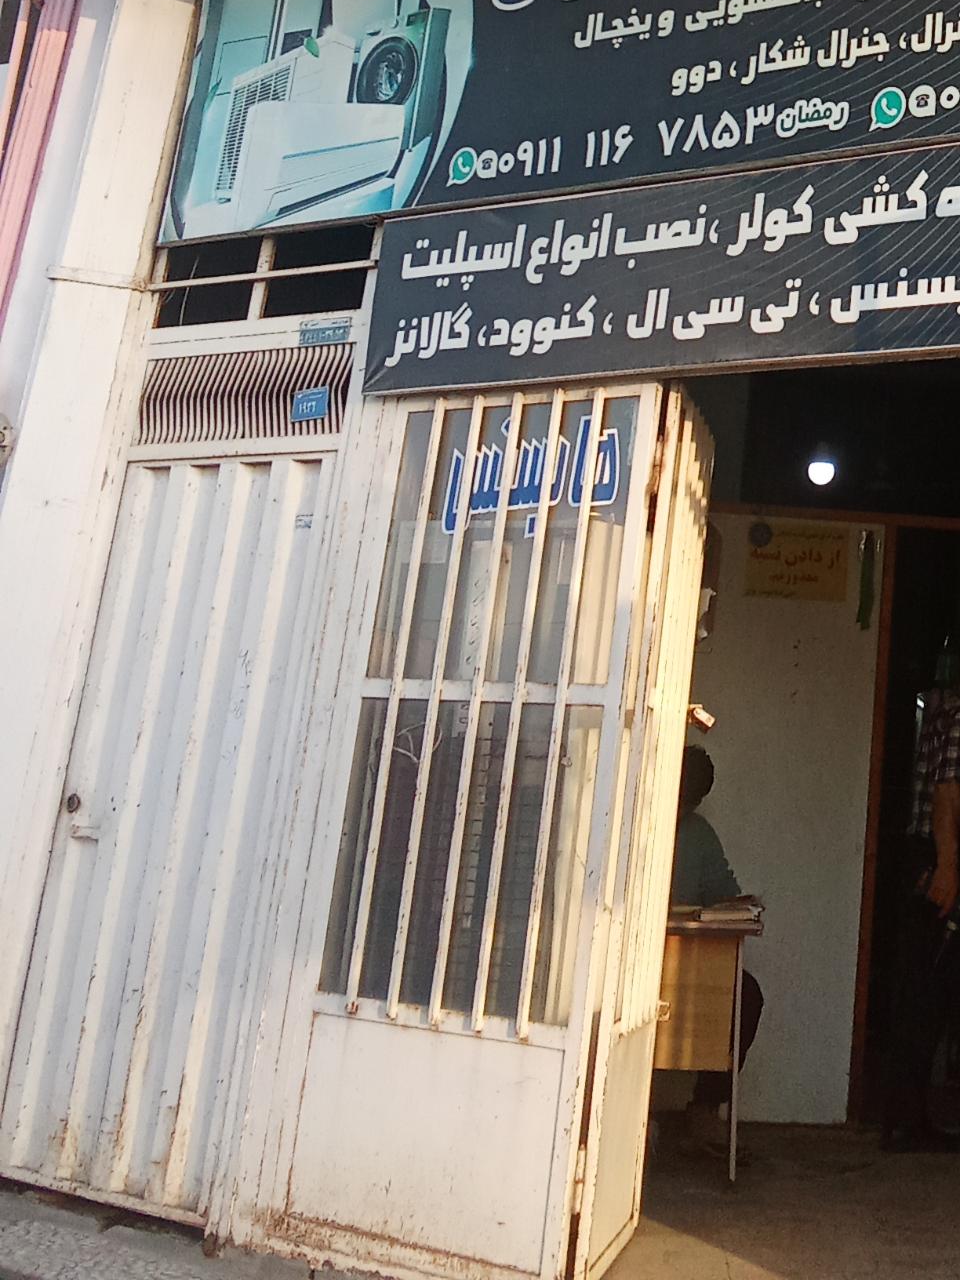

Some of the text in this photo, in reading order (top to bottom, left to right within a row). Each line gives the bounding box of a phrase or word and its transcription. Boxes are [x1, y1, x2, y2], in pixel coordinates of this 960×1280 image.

[670, 60, 721, 97] دوو
[816, 28, 890, 70] جنرال
[823, 168, 930, 246] کشی
[401, 223, 526, 291] اسپلیت
[525, 212, 613, 284] انواع
[384, 301, 474, 369] گالانز
[672, 295, 744, 342] سی
[750, 278, 802, 335] تی
